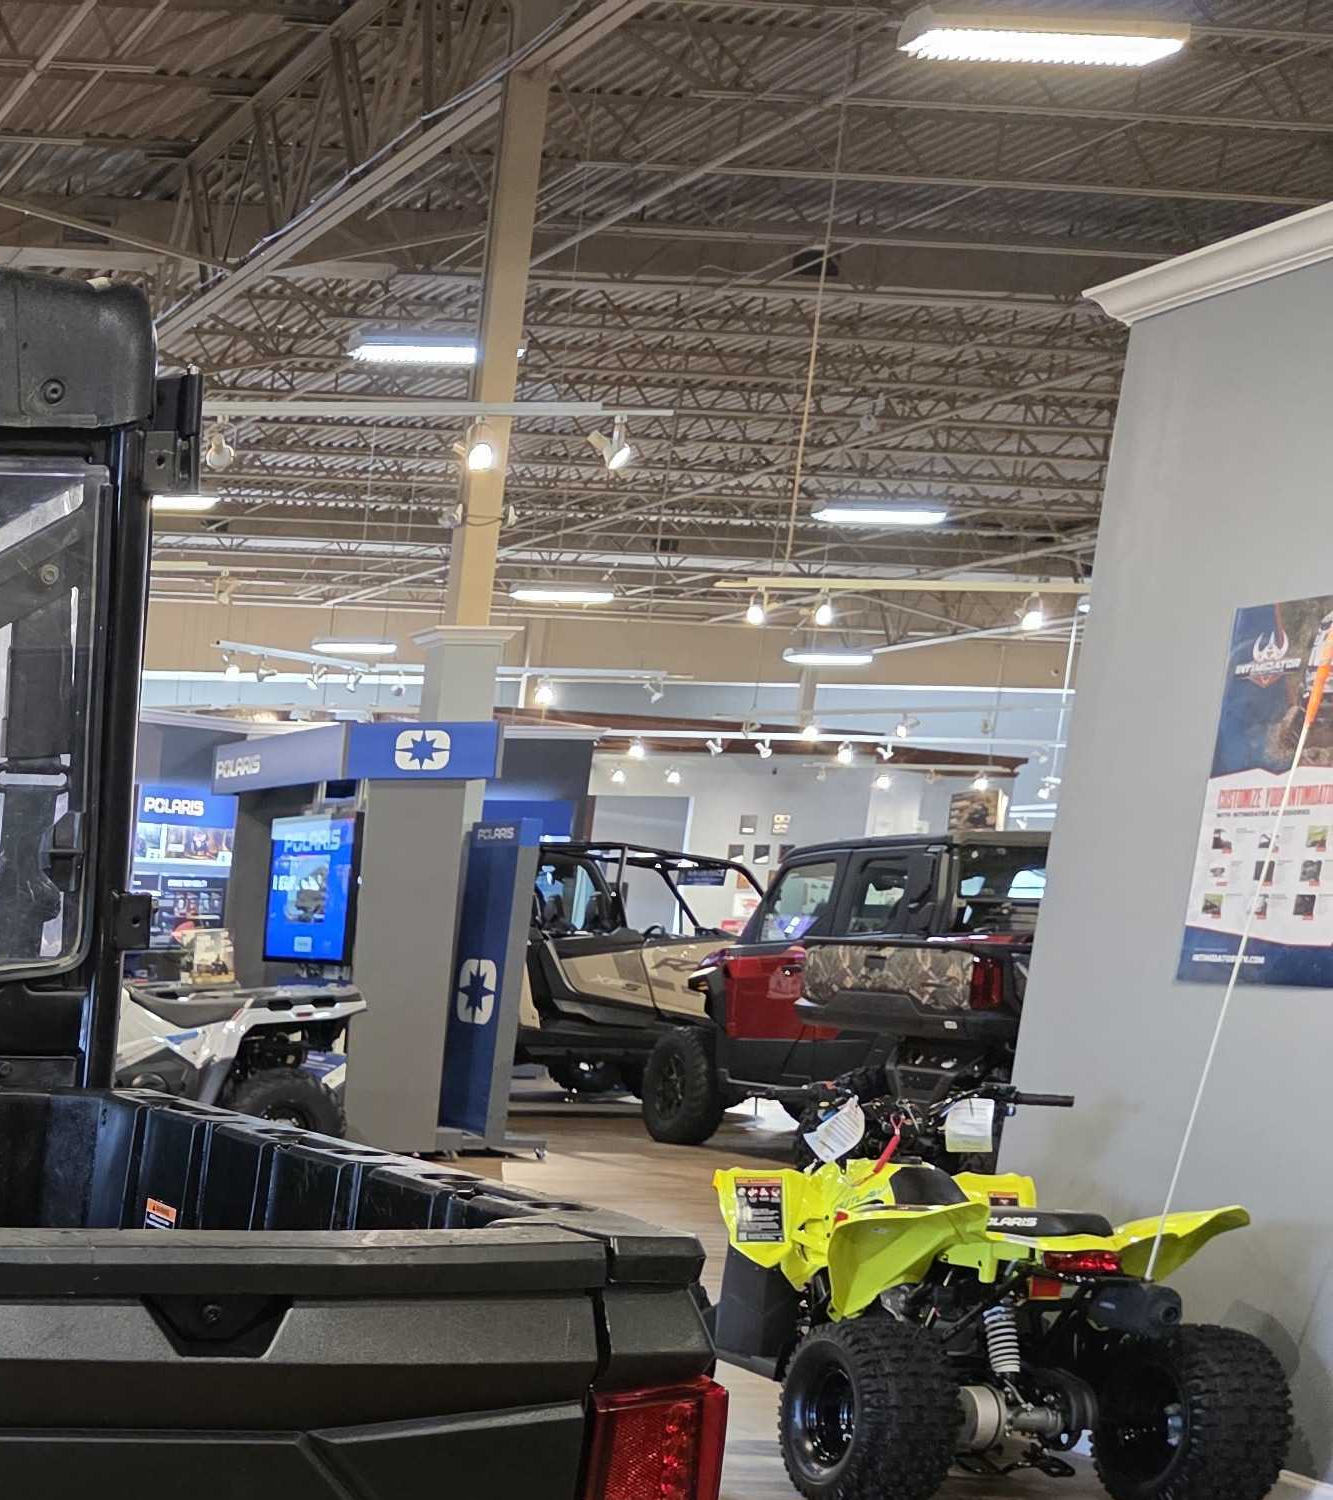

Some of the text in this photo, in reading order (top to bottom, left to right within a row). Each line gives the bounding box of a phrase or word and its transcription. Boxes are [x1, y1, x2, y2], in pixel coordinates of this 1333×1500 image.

[214, 754, 262, 780] POLARIS
[143, 796, 205, 817] POLARIS
[283, 828, 342, 854] POLARIS
[477, 826, 515, 841] POLARIS
